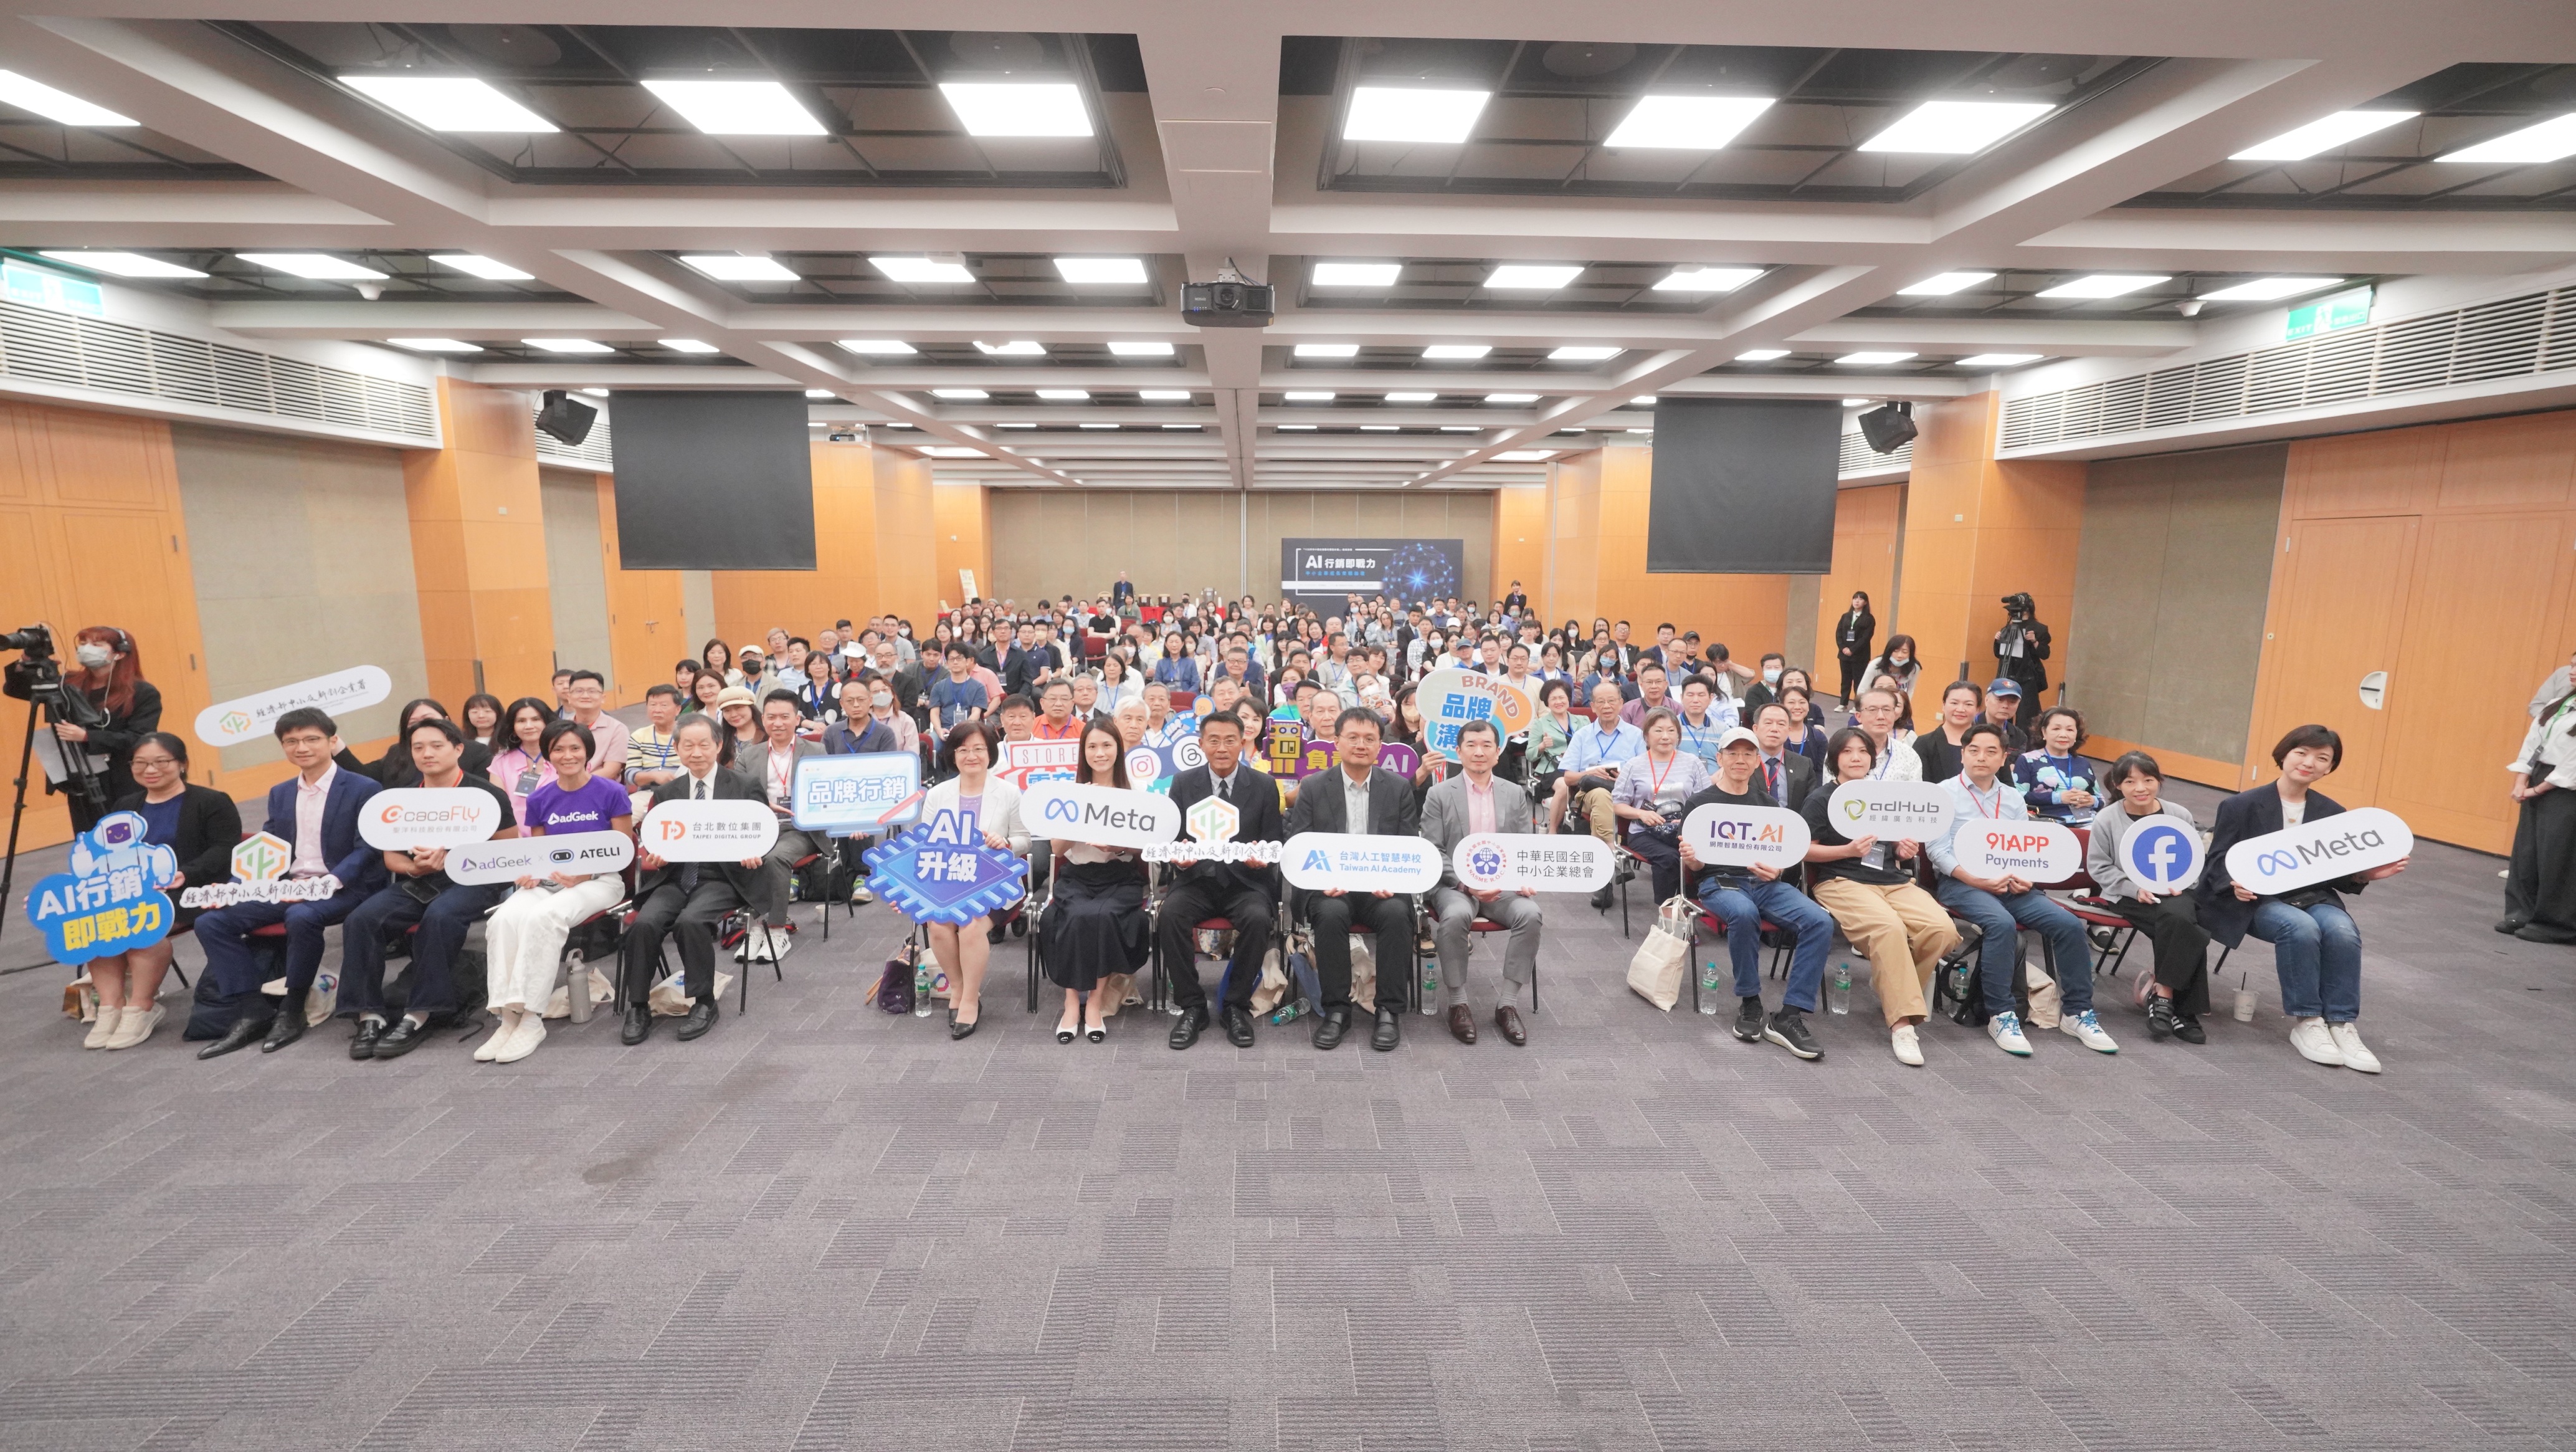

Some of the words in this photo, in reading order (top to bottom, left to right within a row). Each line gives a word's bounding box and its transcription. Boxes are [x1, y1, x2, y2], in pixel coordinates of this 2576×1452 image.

[2287, 323, 2313, 336] EXIT
[1461, 676, 1518, 717] BRAND
[1442, 693, 1492, 721] 品牌
[1022, 747, 1077, 764] STORE
[809, 776, 906, 804] 品牌行銷
[404, 806, 480, 822] cacaFly
[1870, 801, 1939, 813] adHub
[559, 811, 599, 823] adGeek
[1084, 803, 1156, 832] Meta
[1869, 814, 1937, 823] 經緯廣告科技
[693, 821, 761, 831] 台北數位集團
[927, 812, 972, 845] AI
[1711, 821, 1784, 843] IQT.AI
[1709, 841, 1782, 852] 網際智慧股份有限公司
[1986, 833, 2050, 853] 91APP
[2296, 829, 2385, 865] Meta
[479, 855, 532, 870] adGeek
[580, 846, 620, 859] ATELLI
[1339, 851, 1421, 863] 台灣人工智慧學校
[1517, 850, 1594, 863] 中華民國全國
[1985, 854, 2049, 869] Payments
[917, 851, 977, 882] 升級
[1339, 863, 1369, 872] Taiwan
[1381, 864, 1421, 875] Academy
[1517, 865, 1594, 878] 中小企業總會
[1468, 869, 1488, 883] NASME
[37, 867, 143, 920] AI行銷
[184, 881, 333, 905] 經濟部中小及新創企業署
[62, 902, 161, 952] 即戰力
